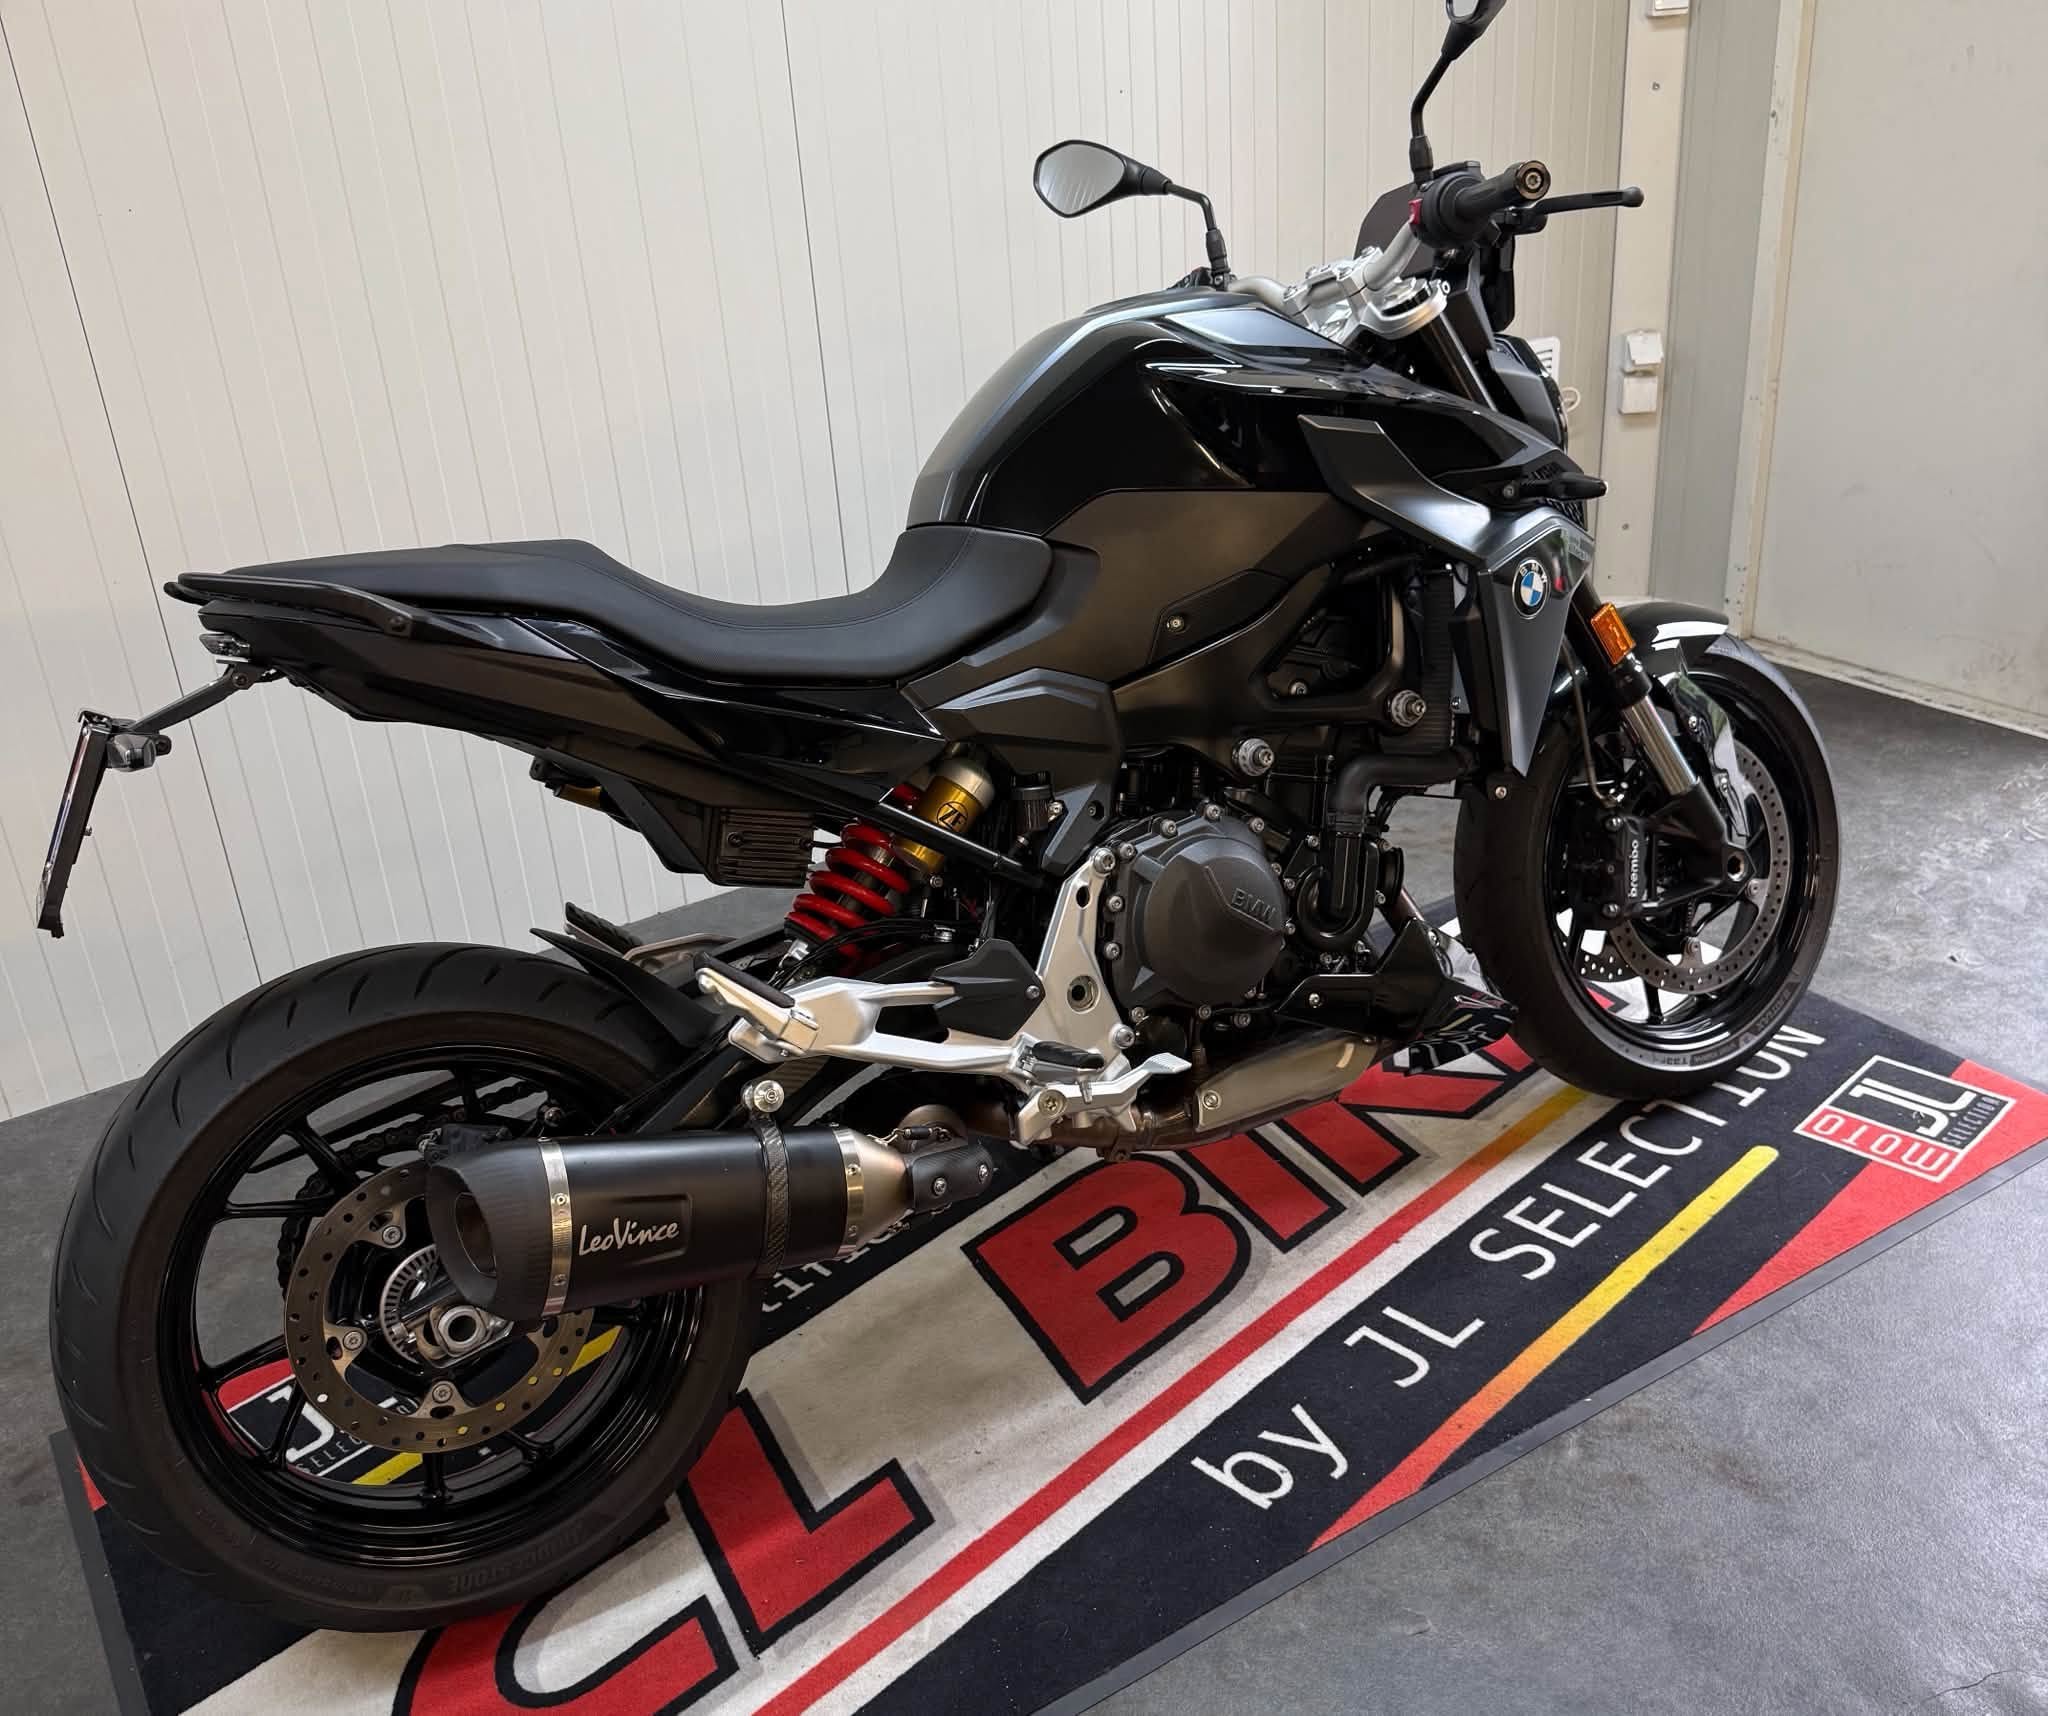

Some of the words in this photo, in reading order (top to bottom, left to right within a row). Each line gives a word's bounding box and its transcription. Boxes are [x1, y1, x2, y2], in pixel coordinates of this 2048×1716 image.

[938, 802, 967, 831] ZF
[1628, 839, 1640, 897] brembo
[1848, 1077, 1978, 1137] JL
[1812, 1113, 1950, 1171] MOTO
[578, 1217, 680, 1256] LeoVince
[1190, 1404, 1349, 1510] by
[1343, 1305, 1486, 1388] JL
